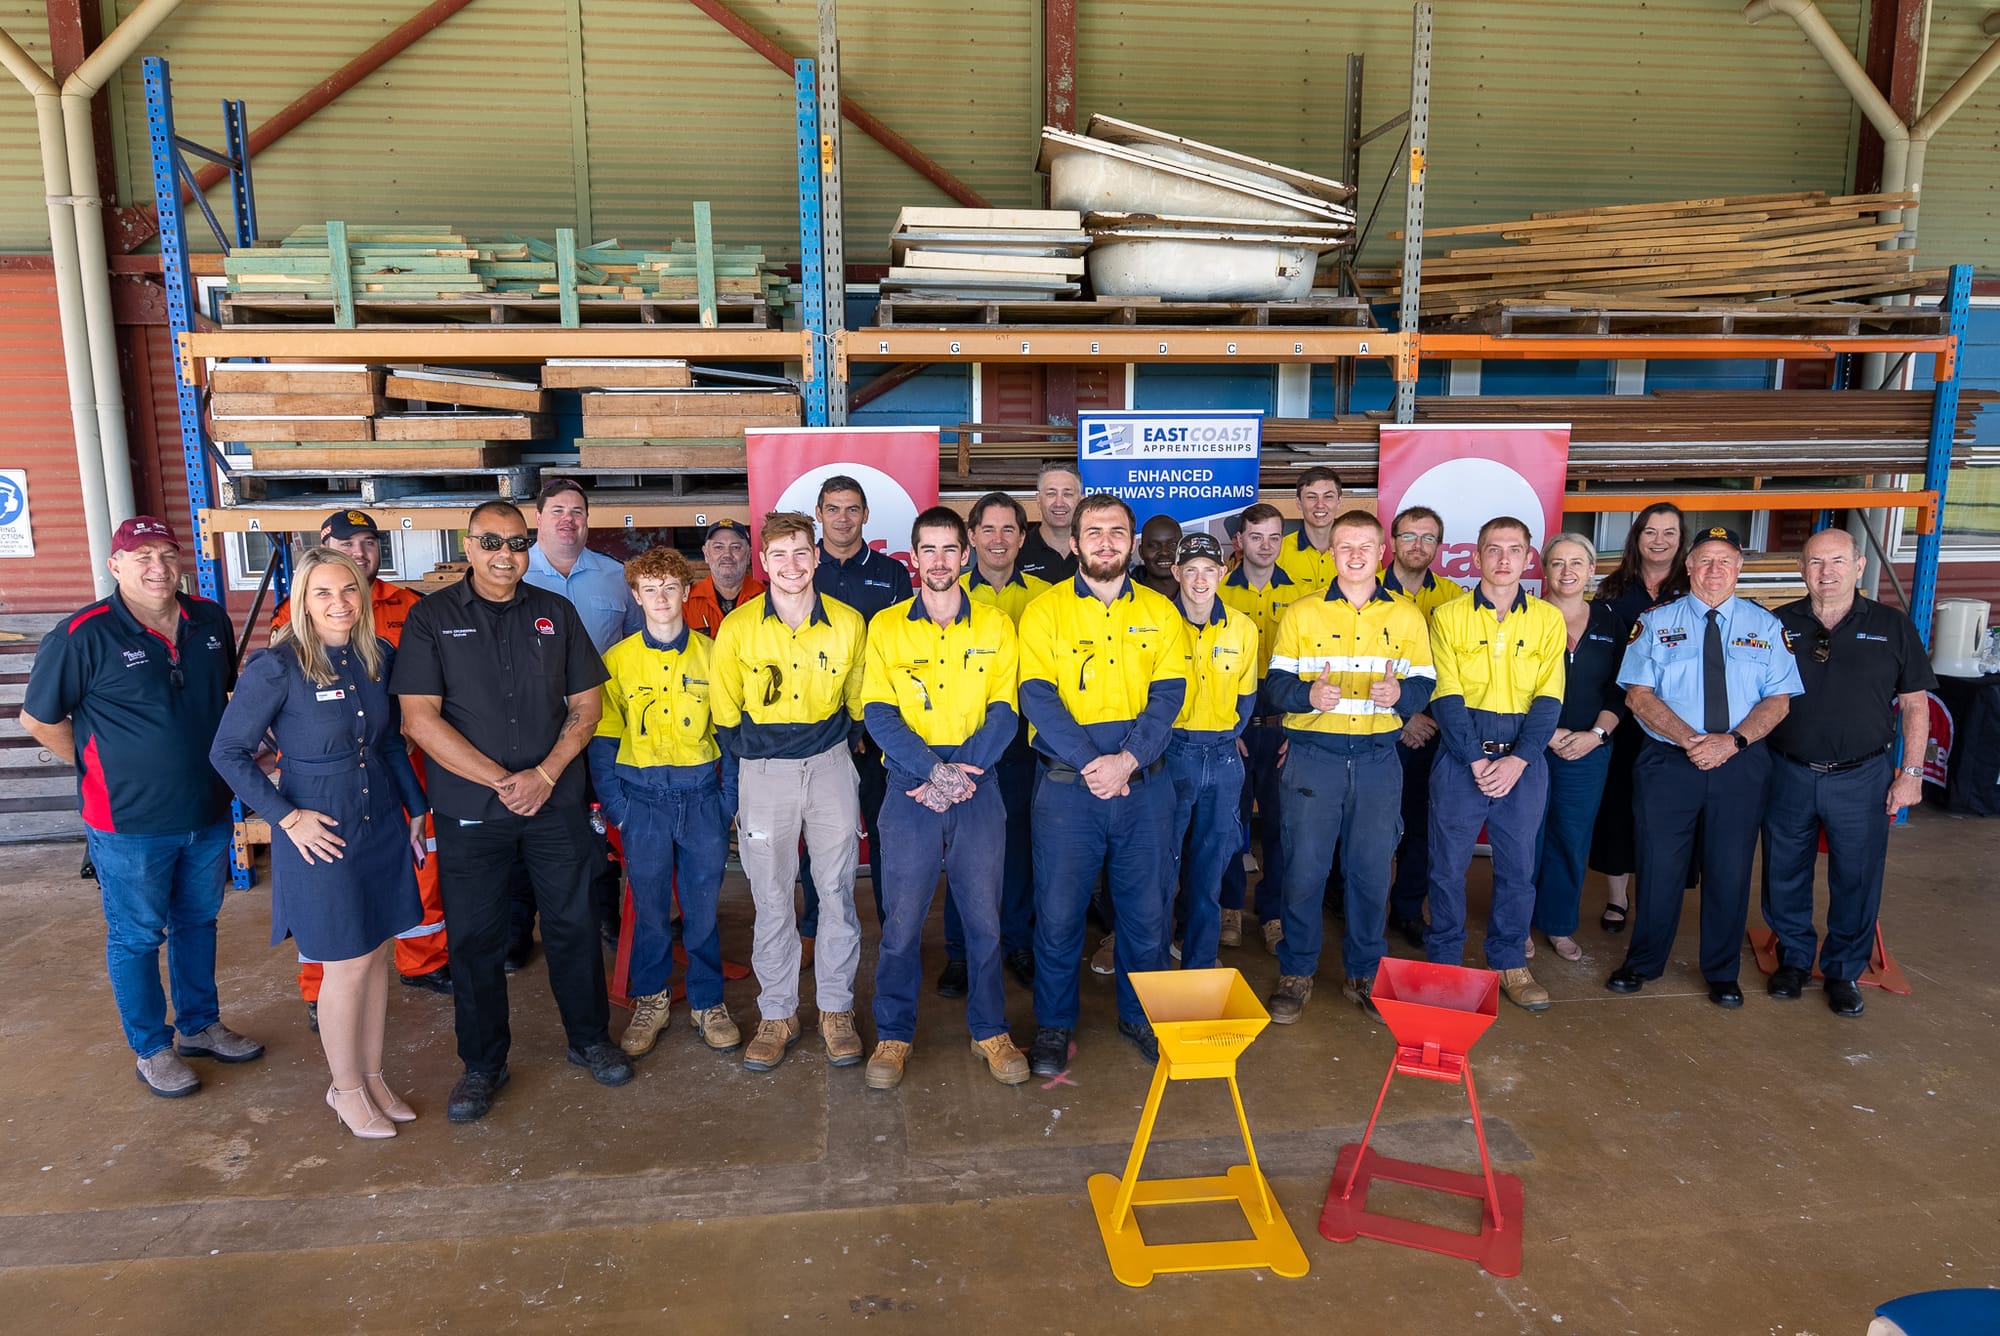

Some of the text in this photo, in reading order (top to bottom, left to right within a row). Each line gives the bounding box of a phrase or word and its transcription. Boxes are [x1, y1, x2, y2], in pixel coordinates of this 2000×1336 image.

[880, 343, 888, 352] H
[951, 343, 960, 353] G
[1022, 343, 1029, 352] F
[1091, 343, 1098, 353] E
[1159, 344, 1167, 353] D
[1227, 344, 1236, 353] C
[1295, 344, 1302, 353] B
[1360, 344, 1368, 353] A
[1143, 443, 1252, 452] APPRENTICESHIPS
[1128, 469, 1213, 483] ENHANCED
[1084, 485, 1254, 499] PATHWAYS PROGRAMS
[251, 520, 259, 530] A
[402, 518, 411, 529] C
[625, 516, 632, 526] F
[696, 515, 705, 525] G
